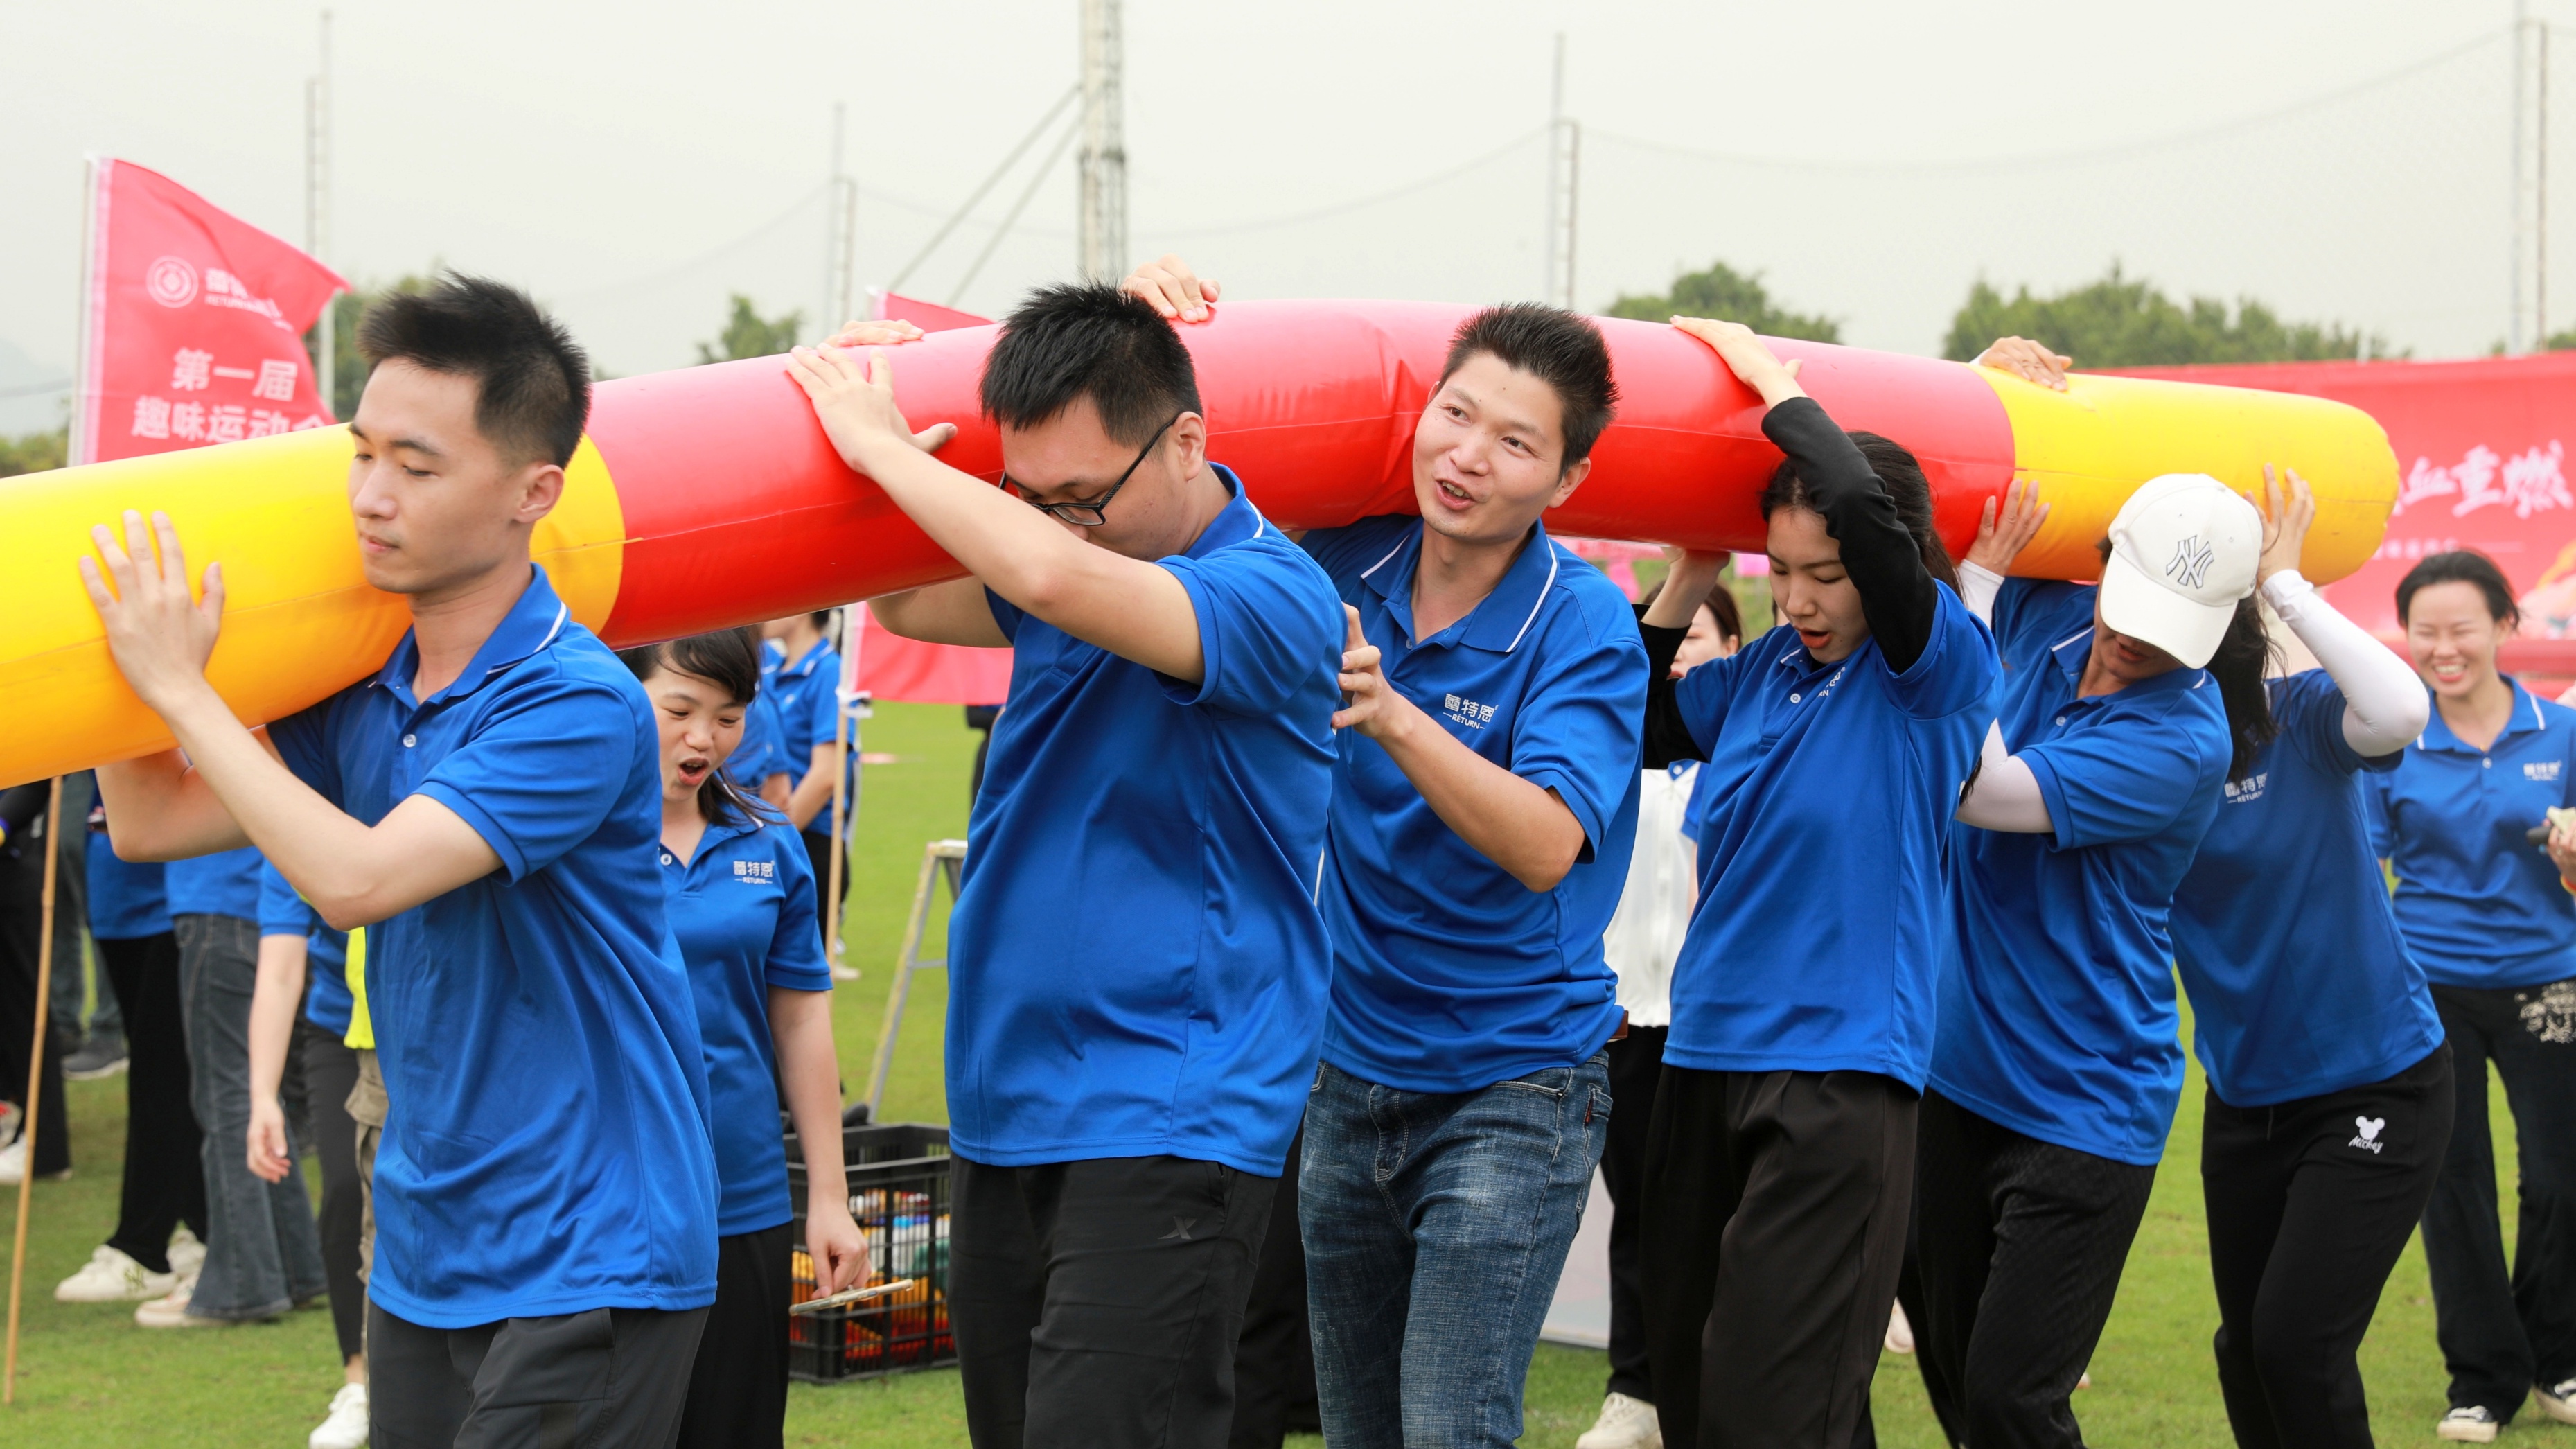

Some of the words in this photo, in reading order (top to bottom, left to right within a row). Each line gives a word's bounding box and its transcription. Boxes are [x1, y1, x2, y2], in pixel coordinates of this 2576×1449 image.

[170, 347, 298, 402] 第一届
[2396, 439, 2574, 520] 血重燃
[2166, 534, 2214, 590] NY
[2348, 1135, 2383, 1154] Mickey
